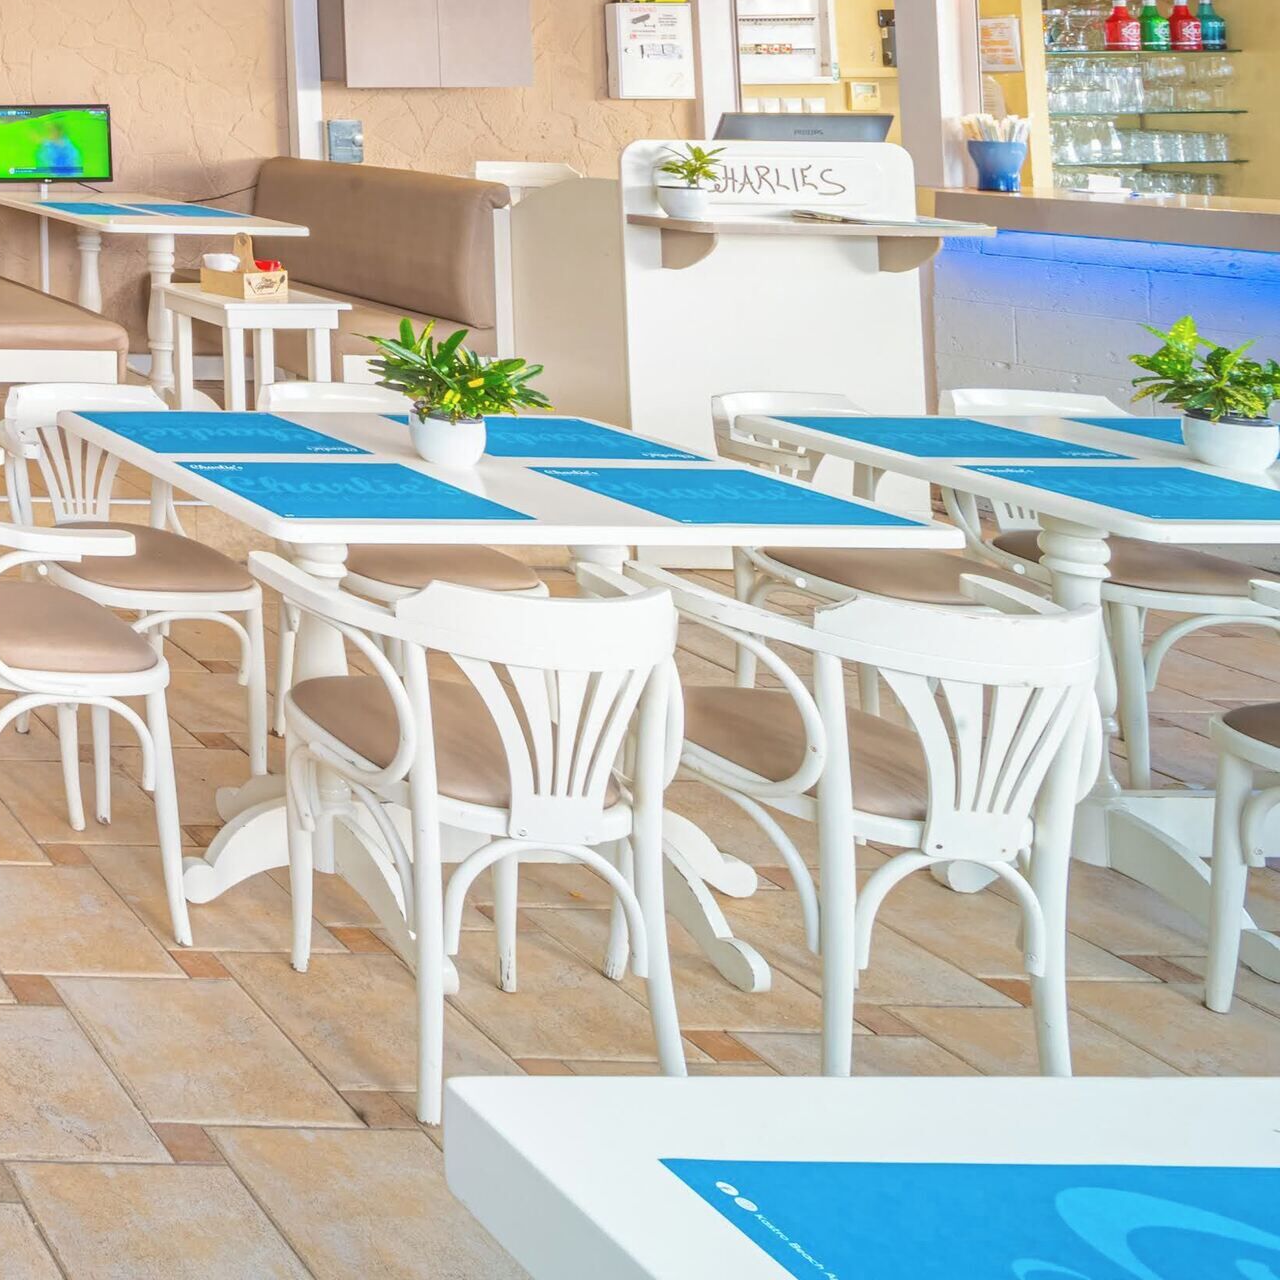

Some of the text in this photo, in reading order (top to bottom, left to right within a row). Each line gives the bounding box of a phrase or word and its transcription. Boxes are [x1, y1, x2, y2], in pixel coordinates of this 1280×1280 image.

[707, 164, 847, 196] HARLIES
[754, 1213, 825, 1270] Kastro Beach
